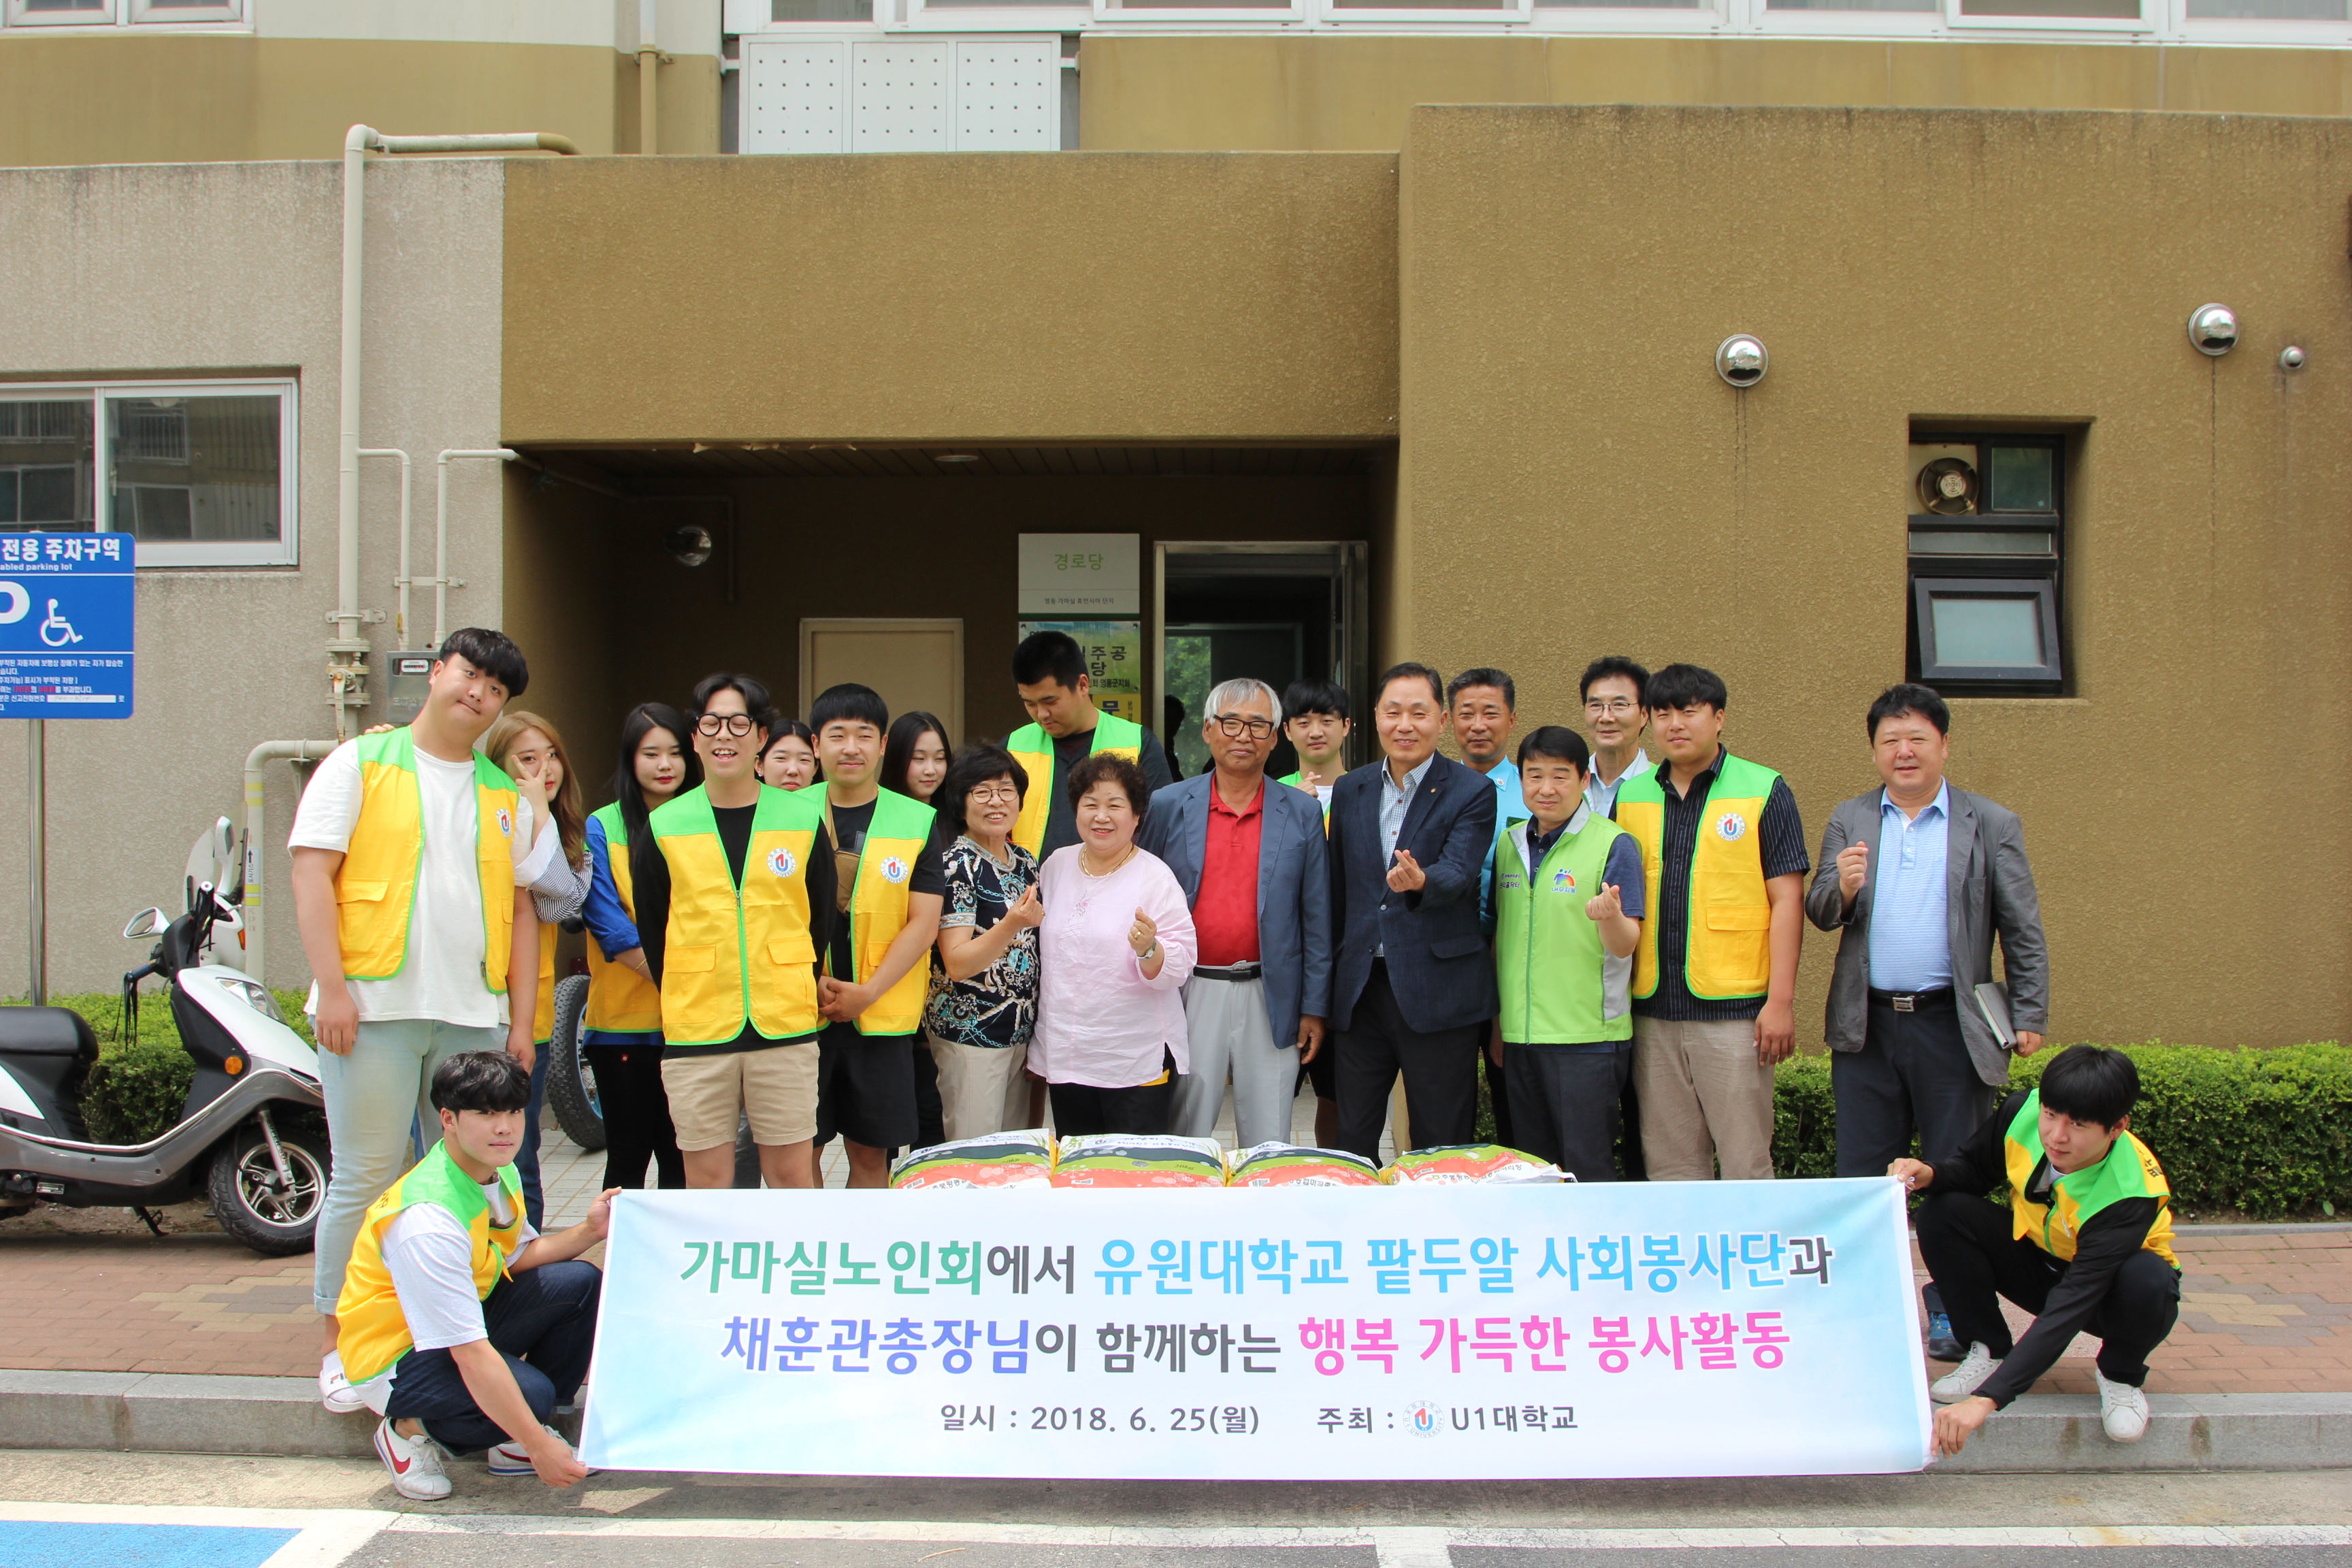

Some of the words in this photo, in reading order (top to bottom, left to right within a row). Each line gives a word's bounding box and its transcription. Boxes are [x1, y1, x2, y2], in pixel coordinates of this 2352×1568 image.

[2, 538, 39, 561] 전용
[46, 538, 120, 561] 주차구역
[26, 563, 59, 571] parking
[1054, 553, 1104, 570] 경로당
[41, 659, 59, 668] 보행상
[105, 659, 124, 668] 탑승한
[1100, 679, 1130, 687] 영동군지회
[681, 1241, 1075, 1295] 가마실노인회에서
[1094, 1239, 1348, 1294] 유원대학교
[1367, 1237, 1518, 1294] 팥두알
[1536, 1233, 1832, 1292] 사회봉사단과
[721, 1316, 1076, 1374] 채훈관총장님이
[1096, 1322, 1281, 1373] 함께하는
[1298, 1317, 1399, 1375] 행복
[1419, 1315, 1570, 1373] 가득한
[1588, 1311, 1791, 1373] 봉사활동
[941, 1405, 994, 1431] 일시
[1031, 1406, 1115, 1432] 2018.
[1130, 1407, 1156, 1432] 6.
[1170, 1405, 1259, 1434] 25(월)
[1317, 1407, 1373, 1433] 주최
[1451, 1405, 1578, 1432] U1대학교
